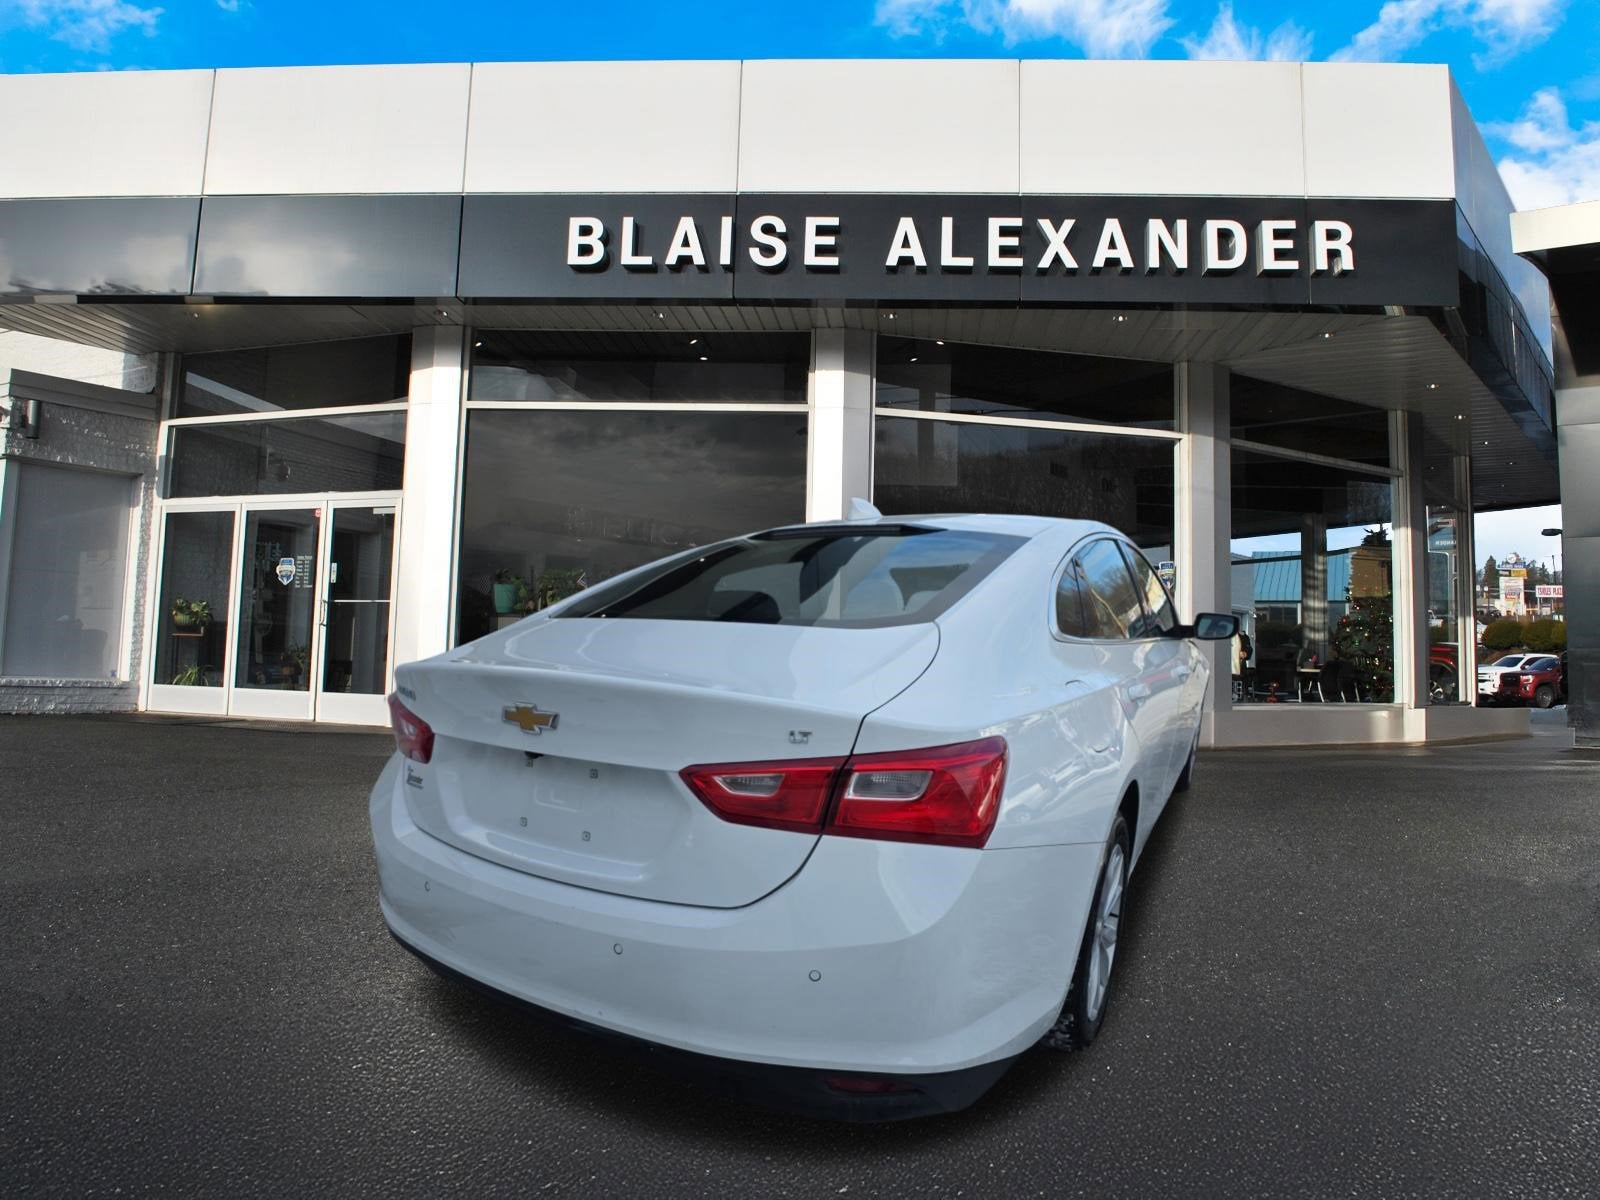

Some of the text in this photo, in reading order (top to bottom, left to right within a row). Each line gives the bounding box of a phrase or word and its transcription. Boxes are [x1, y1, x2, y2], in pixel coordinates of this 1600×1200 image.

[566, 215, 1356, 272] BLAISE ALEXANDER
[788, 730, 812, 744] LT
